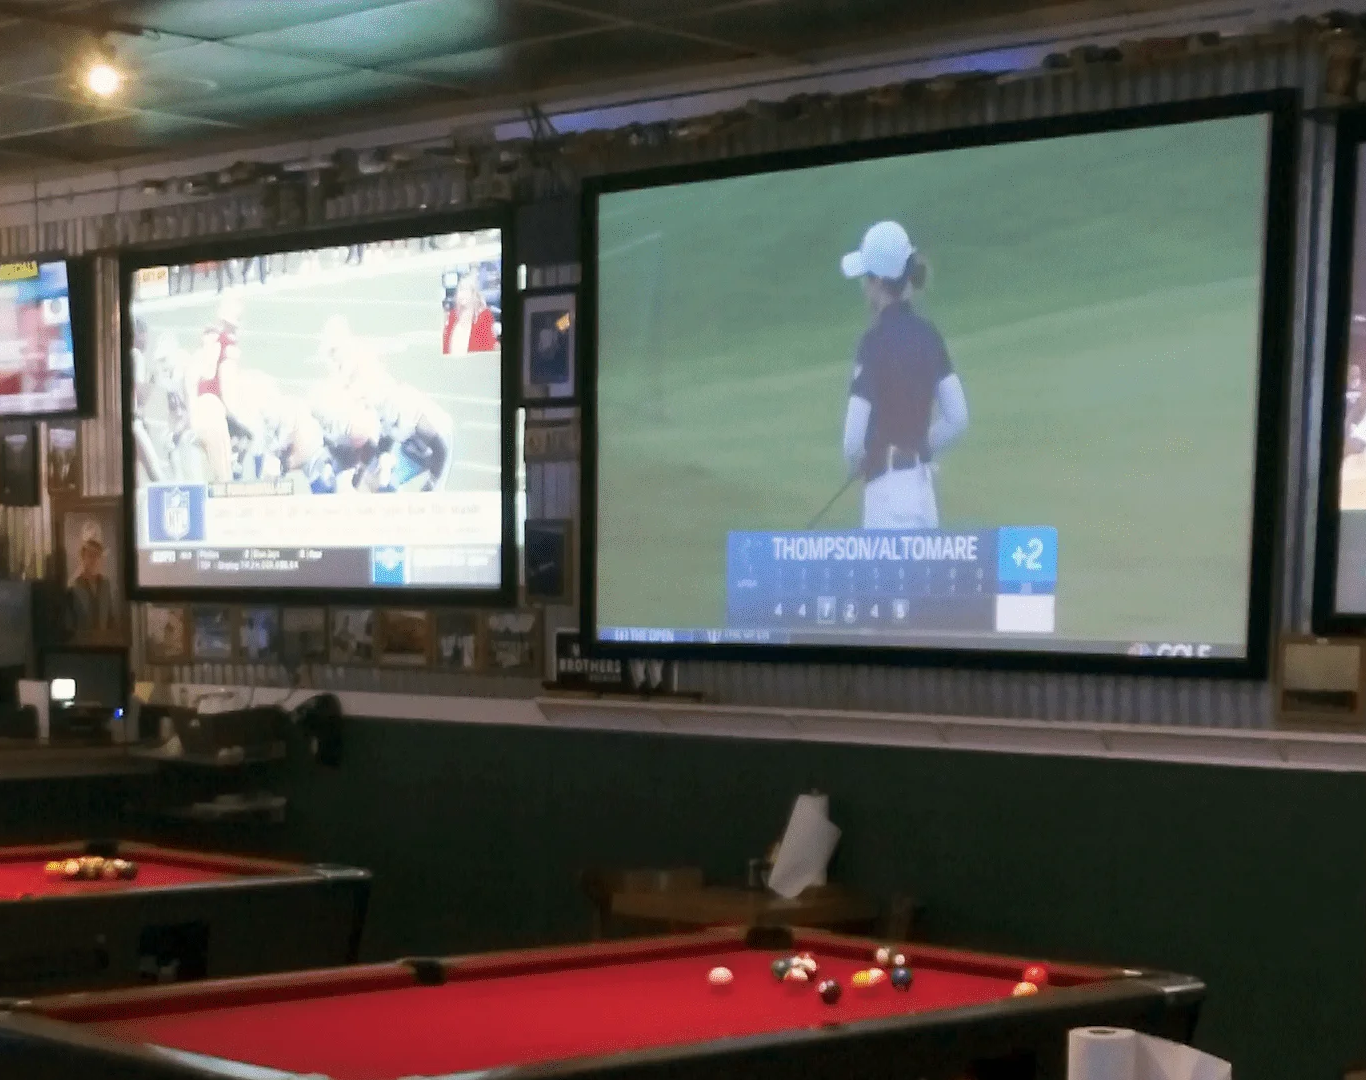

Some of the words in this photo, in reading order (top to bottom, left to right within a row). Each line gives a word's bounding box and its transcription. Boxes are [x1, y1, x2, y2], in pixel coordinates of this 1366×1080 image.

[772, 535, 979, 562] THOMPSON/ALTOMARE
[1011, 537, 1045, 571] +2
[559, 658, 622, 674] BROTHERS
